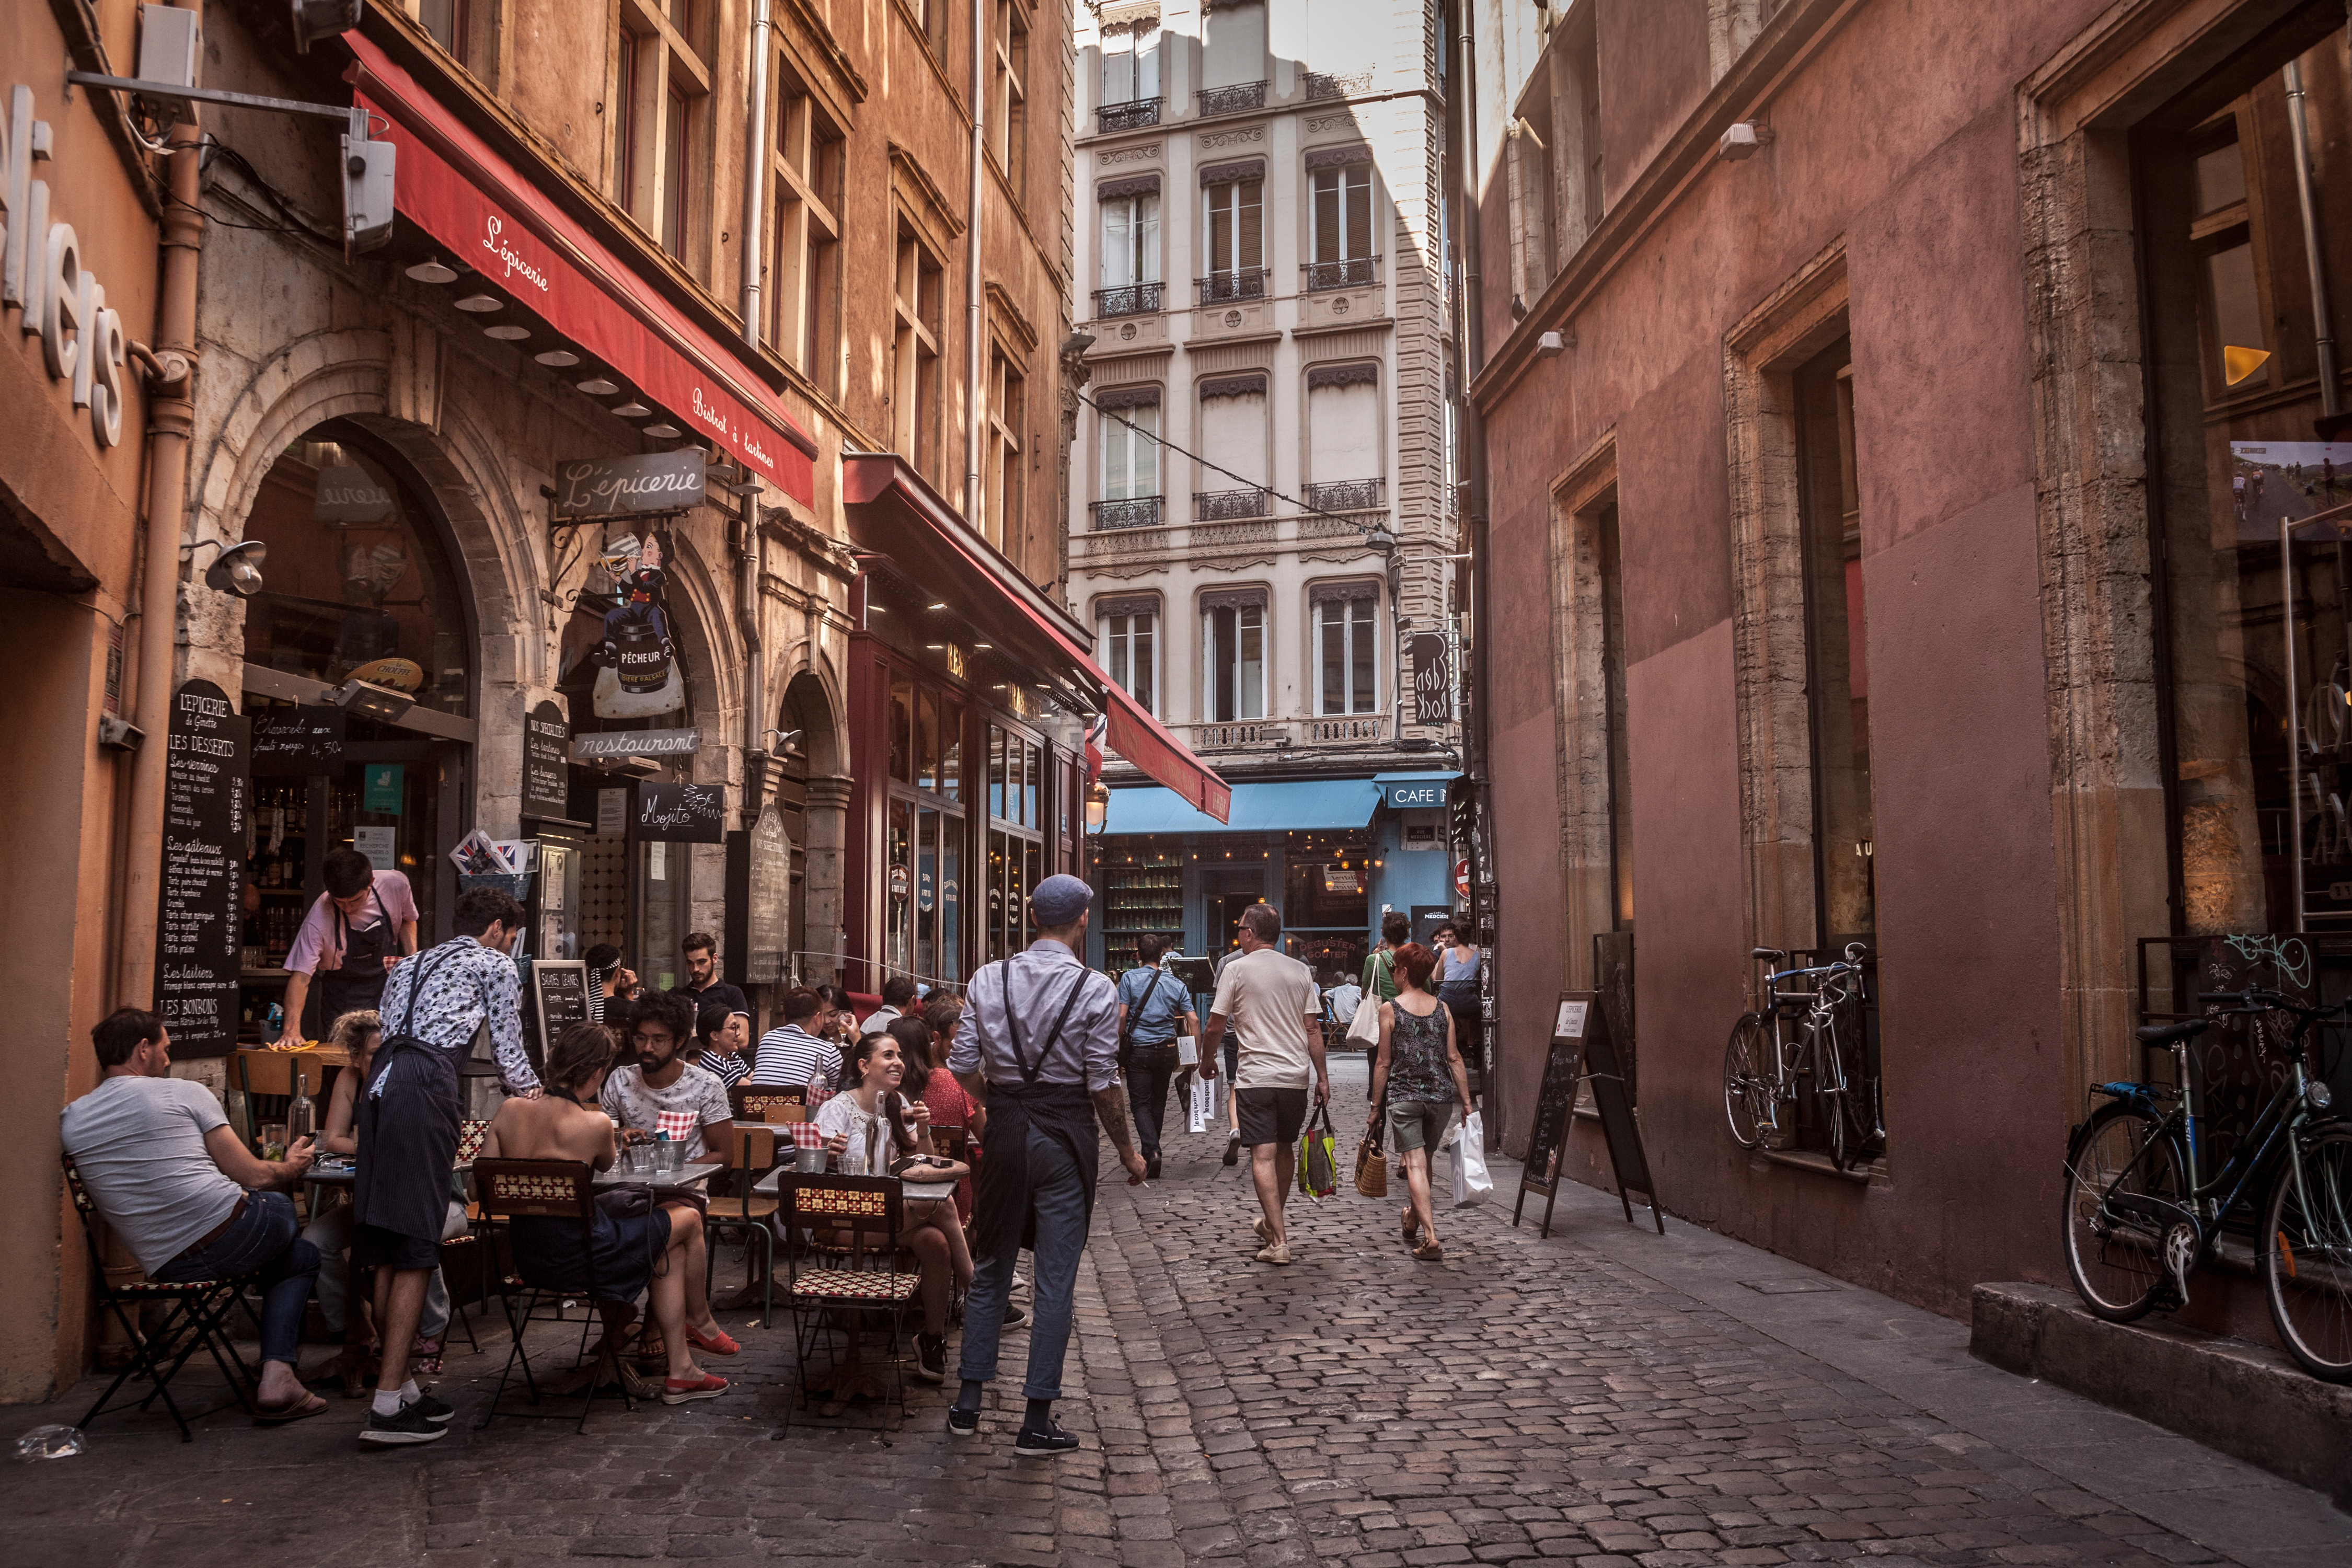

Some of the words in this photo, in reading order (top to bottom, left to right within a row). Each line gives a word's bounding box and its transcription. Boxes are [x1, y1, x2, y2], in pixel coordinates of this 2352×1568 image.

[0, 75, 124, 448] liers
[483, 216, 548, 292] L'épicerie
[693, 387, 727, 434] Bistrot
[732, 425, 737, 443] à
[744, 432, 774, 469] tartines
[563, 464, 701, 512] L'épicerie
[621, 652, 660, 664] PÊCHEUR
[377, 665, 411, 676] CHOUFFE
[186, 714, 192, 725] de
[194, 715, 217, 731] Ginette
[531, 719, 539, 732] NOS
[169, 734, 188, 750] LES
[191, 736, 234, 757] DESSERTS
[531, 737, 539, 750] Les
[540, 740, 561, 755] tartines
[579, 732, 698, 754] restaurant
[170, 753, 186, 768] Les
[186, 759, 220, 774] verrines
[531, 764, 539, 776] Les
[539, 765, 558, 780] burgers
[696, 793, 716, 807] 5€
[1395, 789, 1434, 803] CAFE
[641, 795, 693, 831] Mojito
[167, 836, 184, 851] Les
[184, 838, 222, 857] gâteaux
[168, 876, 180, 885] Tarte
[167, 887, 179, 896] Tarte
[166, 910, 179, 919] Tarte
[165, 921, 179, 930] Tarte
[164, 933, 179, 942] Tarte
[164, 943, 178, 953] Tarte
[1299, 939, 1357, 952] DEGUSTER
[164, 963, 181, 978] Les
[182, 964, 214, 978] laitiers
[541, 973, 560, 987] SALADES
[160, 999, 179, 1016] LES
[181, 998, 217, 1015] BONBONS
